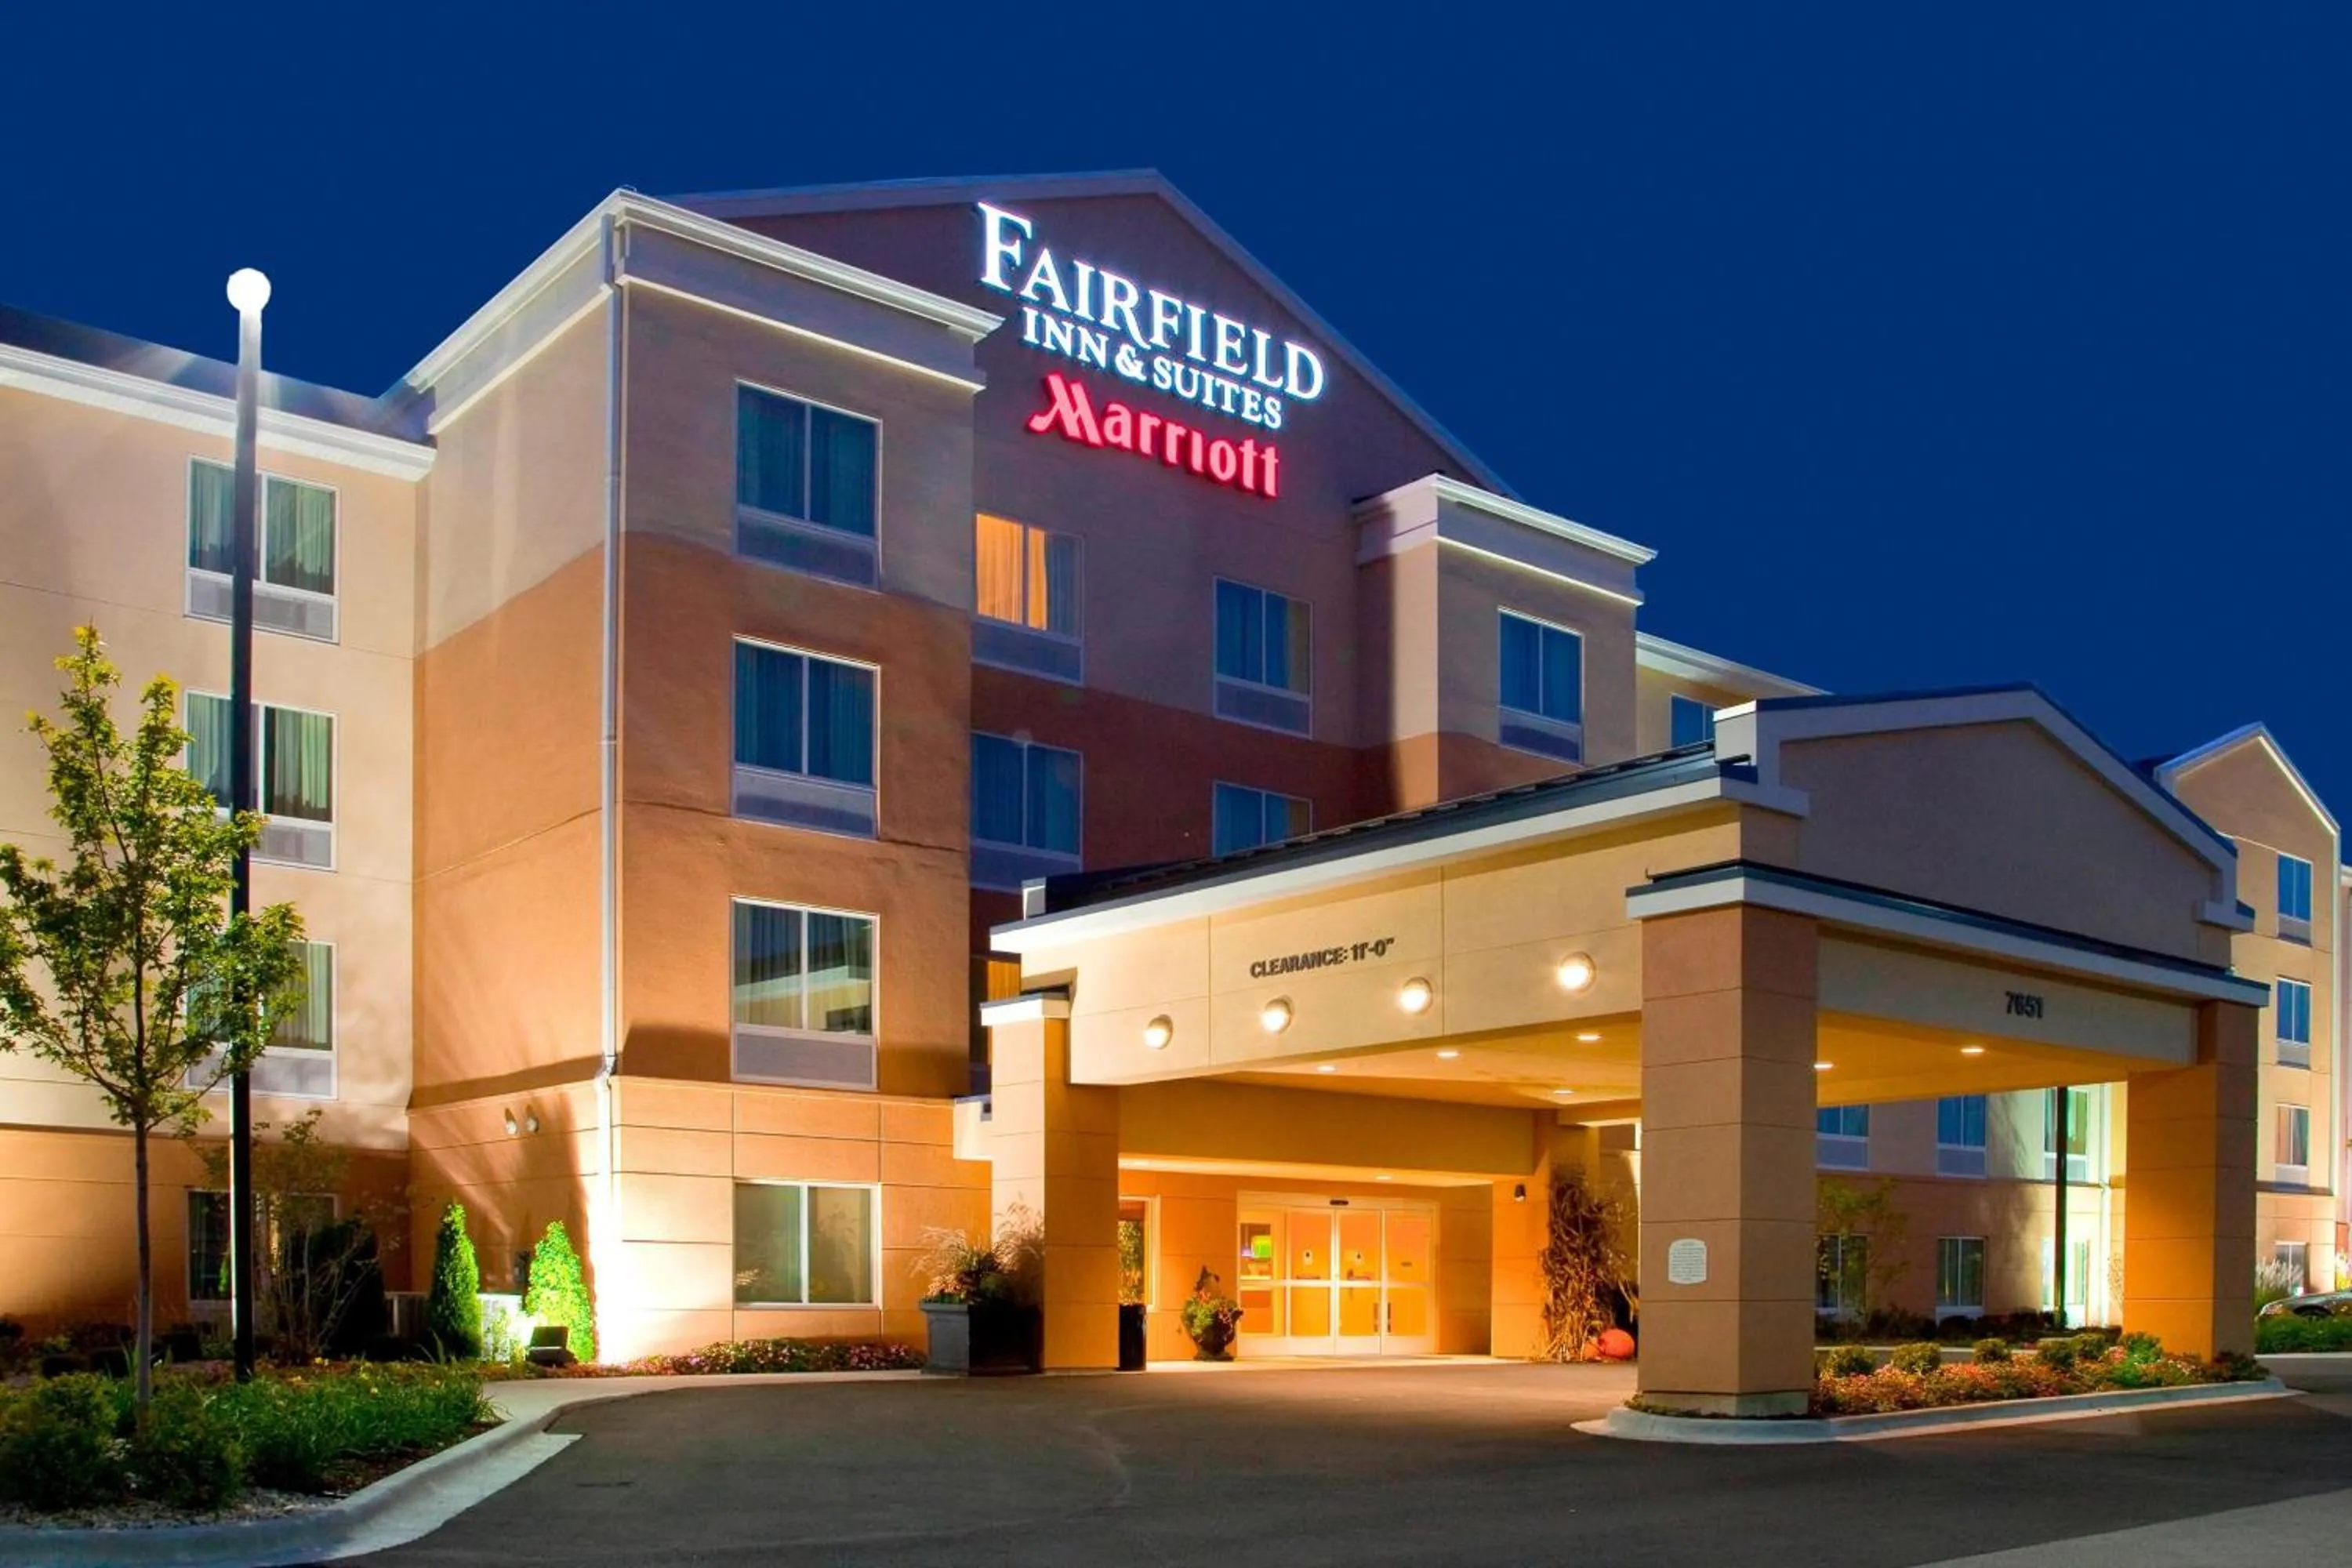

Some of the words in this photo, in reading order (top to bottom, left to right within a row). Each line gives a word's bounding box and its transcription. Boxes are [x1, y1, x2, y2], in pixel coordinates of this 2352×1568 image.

[978, 202, 1324, 400] FAIRFIELD
[1022, 307, 1109, 369] INN
[1116, 343, 1146, 382] &
[1153, 356, 1282, 430] SUITES
[1028, 373, 1279, 499] Marriott
[1250, 946, 1348, 978] CLEARANCE:
